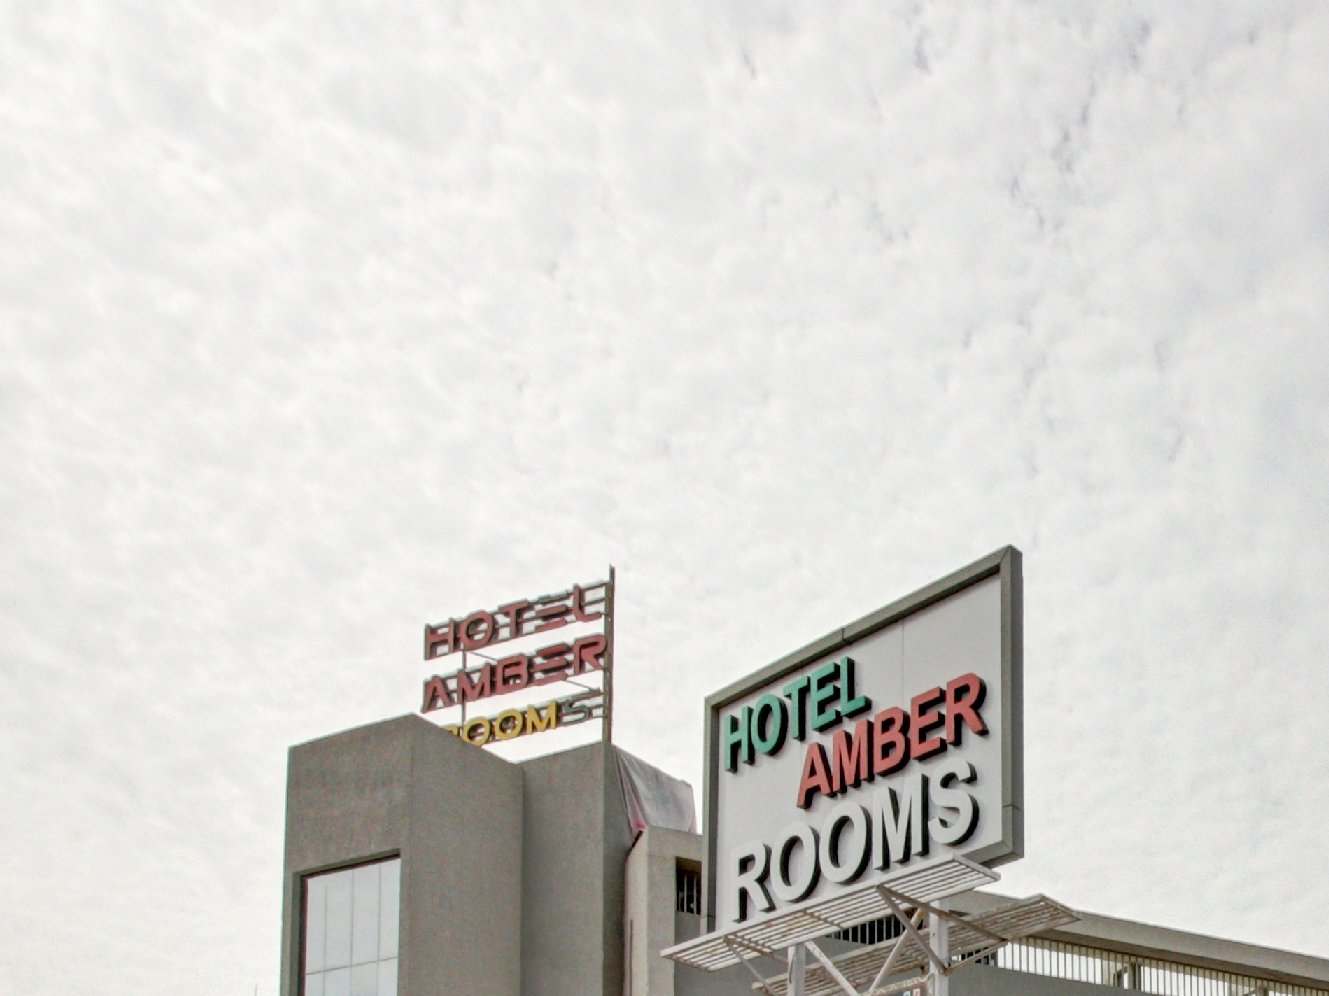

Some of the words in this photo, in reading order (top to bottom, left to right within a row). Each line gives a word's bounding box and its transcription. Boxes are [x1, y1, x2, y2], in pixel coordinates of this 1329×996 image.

[421, 634, 608, 713] AMBER
[424, 583, 603, 660] HOTEL
[724, 656, 868, 772] HOTEL
[797, 673, 986, 807] AMBER
[731, 758, 977, 921] ROOMS
